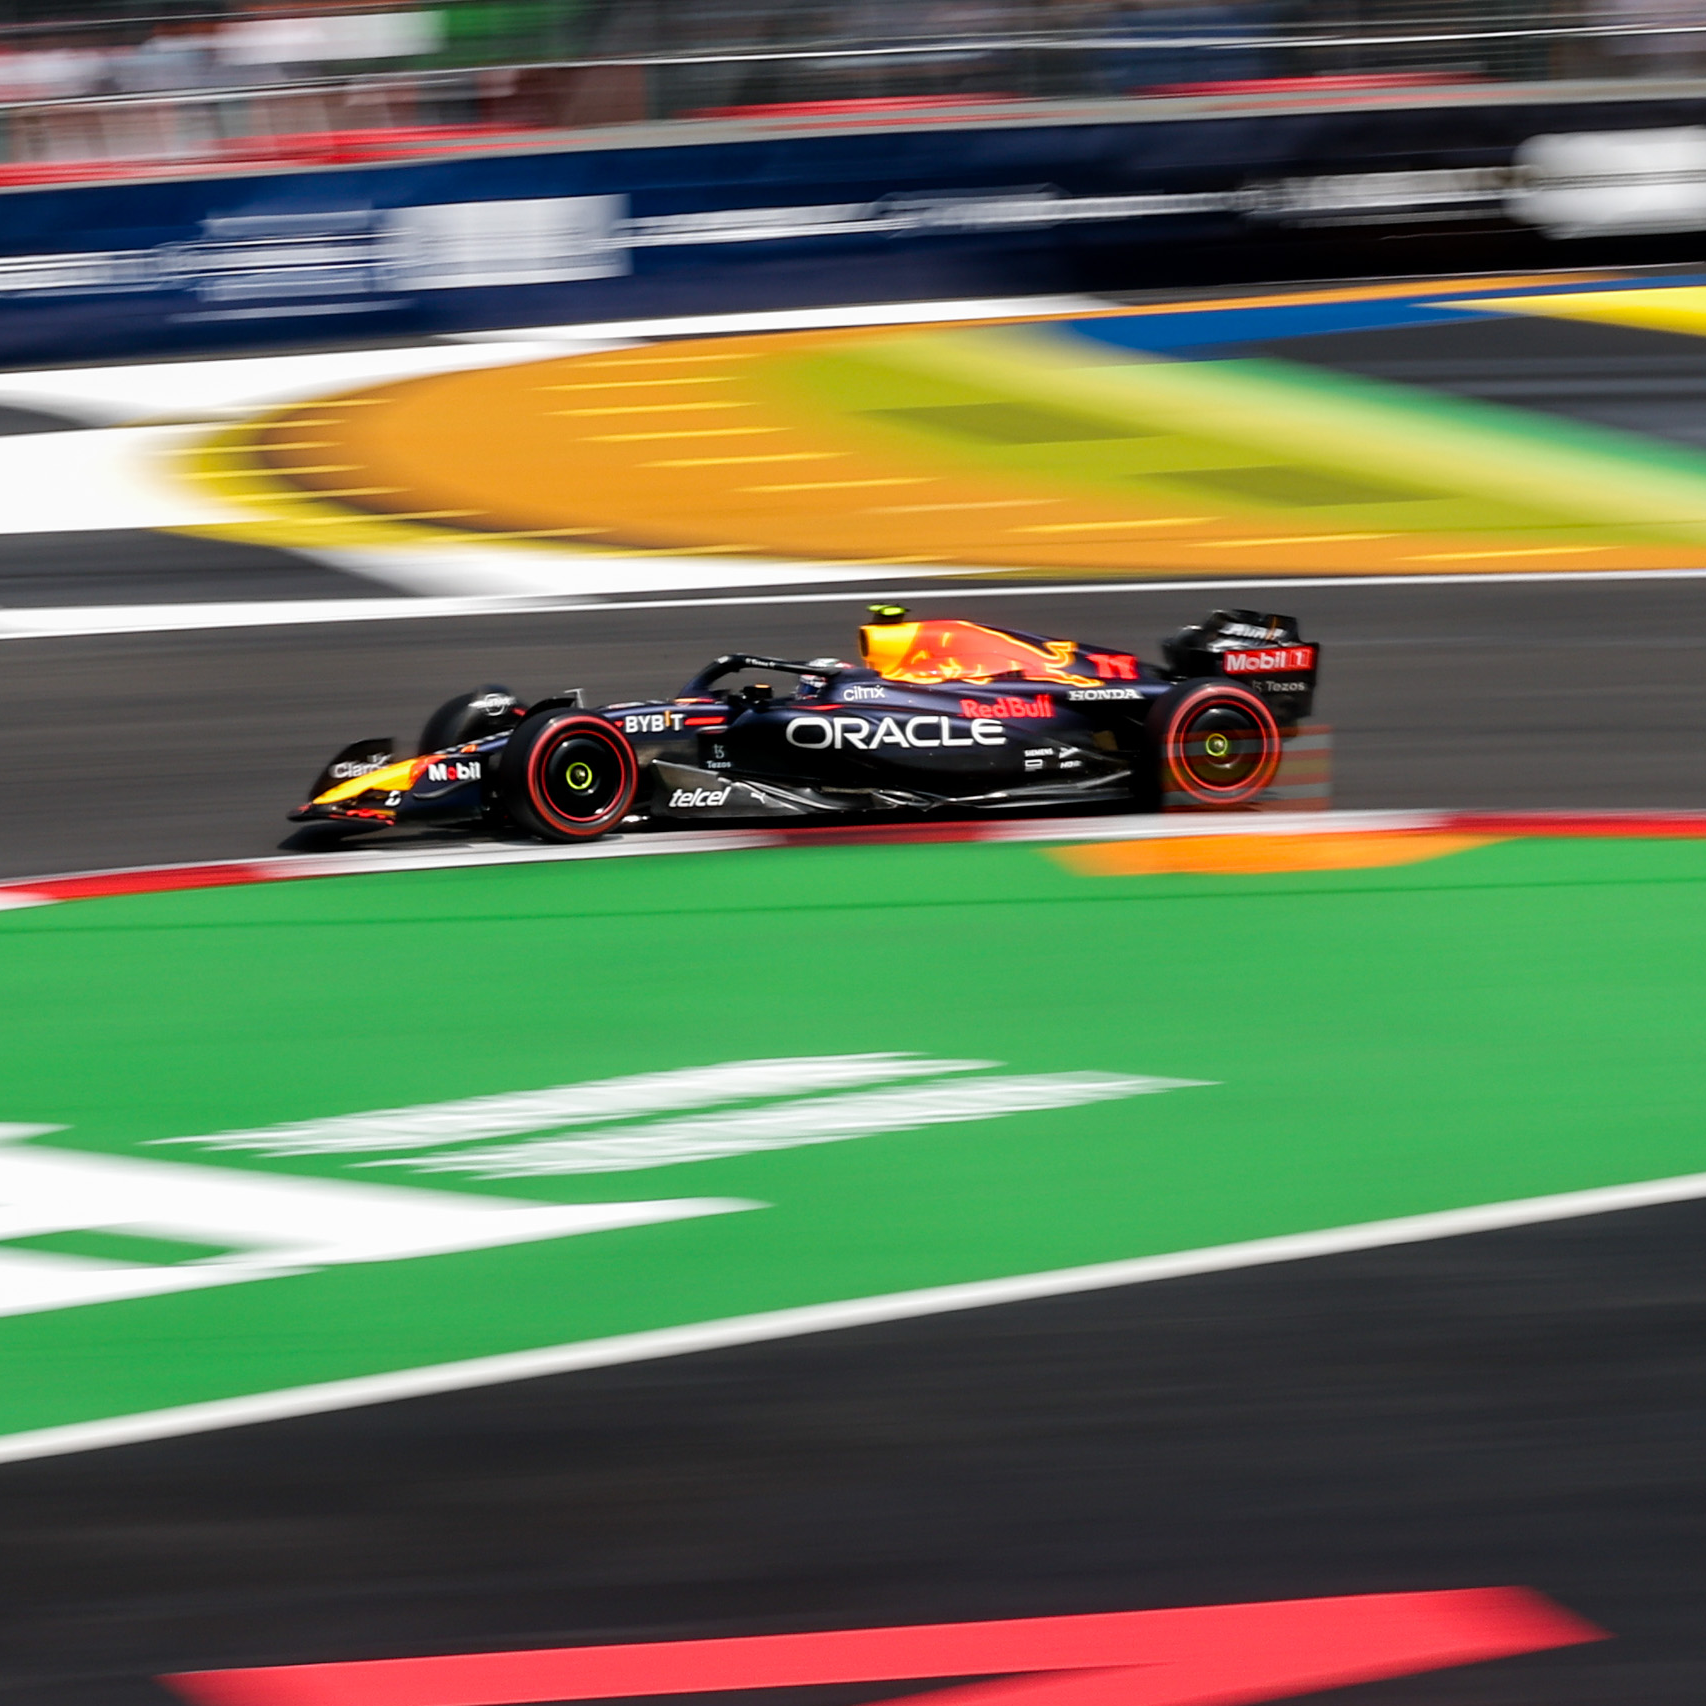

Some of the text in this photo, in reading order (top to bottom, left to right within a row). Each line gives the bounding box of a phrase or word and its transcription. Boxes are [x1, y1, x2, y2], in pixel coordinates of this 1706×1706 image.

[1085, 654, 1139, 680] 11
[1226, 651, 1286, 672] Mobil
[843, 684, 885, 701] citrix
[1067, 688, 1143, 701] HONDA
[1266, 680, 1305, 692] Tezos
[625, 710, 684, 733] BYBIT
[786, 715, 1007, 750] ORACLE
[428, 761, 481, 782] Mobil
[706, 760, 732, 769] Tezos
[669, 787, 731, 808] telcel
